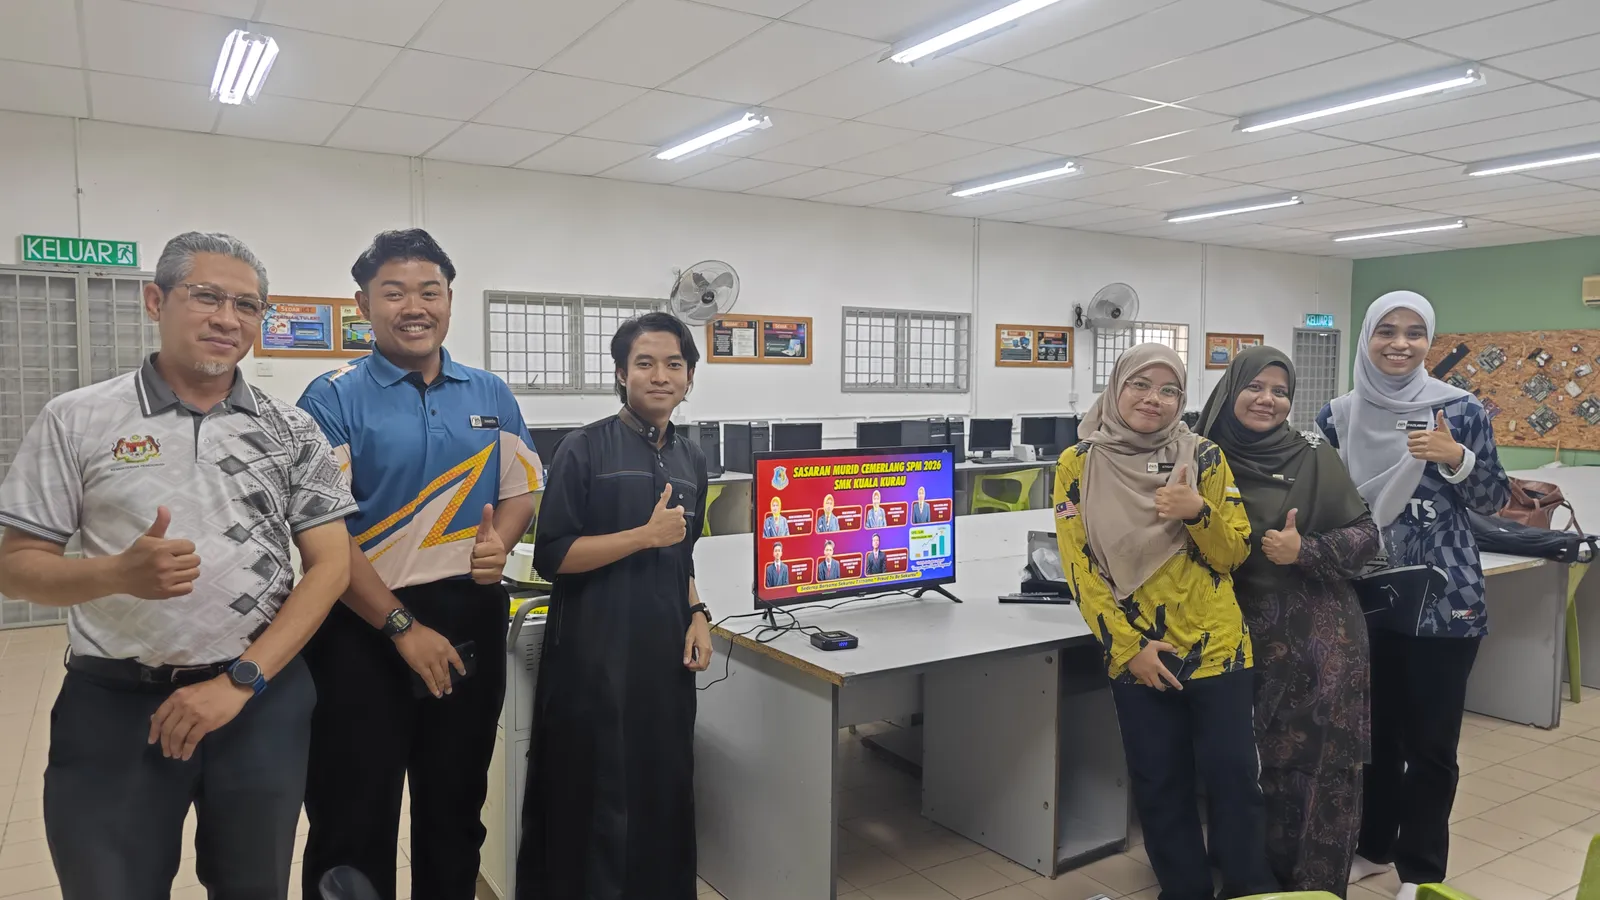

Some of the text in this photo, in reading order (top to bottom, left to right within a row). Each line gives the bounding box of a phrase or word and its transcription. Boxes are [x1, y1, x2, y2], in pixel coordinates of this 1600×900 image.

[27, 238, 112, 262] KELUAR
[1306, 315, 1329, 327] KELUAR
[793, 459, 942, 478] SASARAN MURID CEMERLANG SPM 2026
[834, 475, 907, 490] SMK KUALA KURAU
